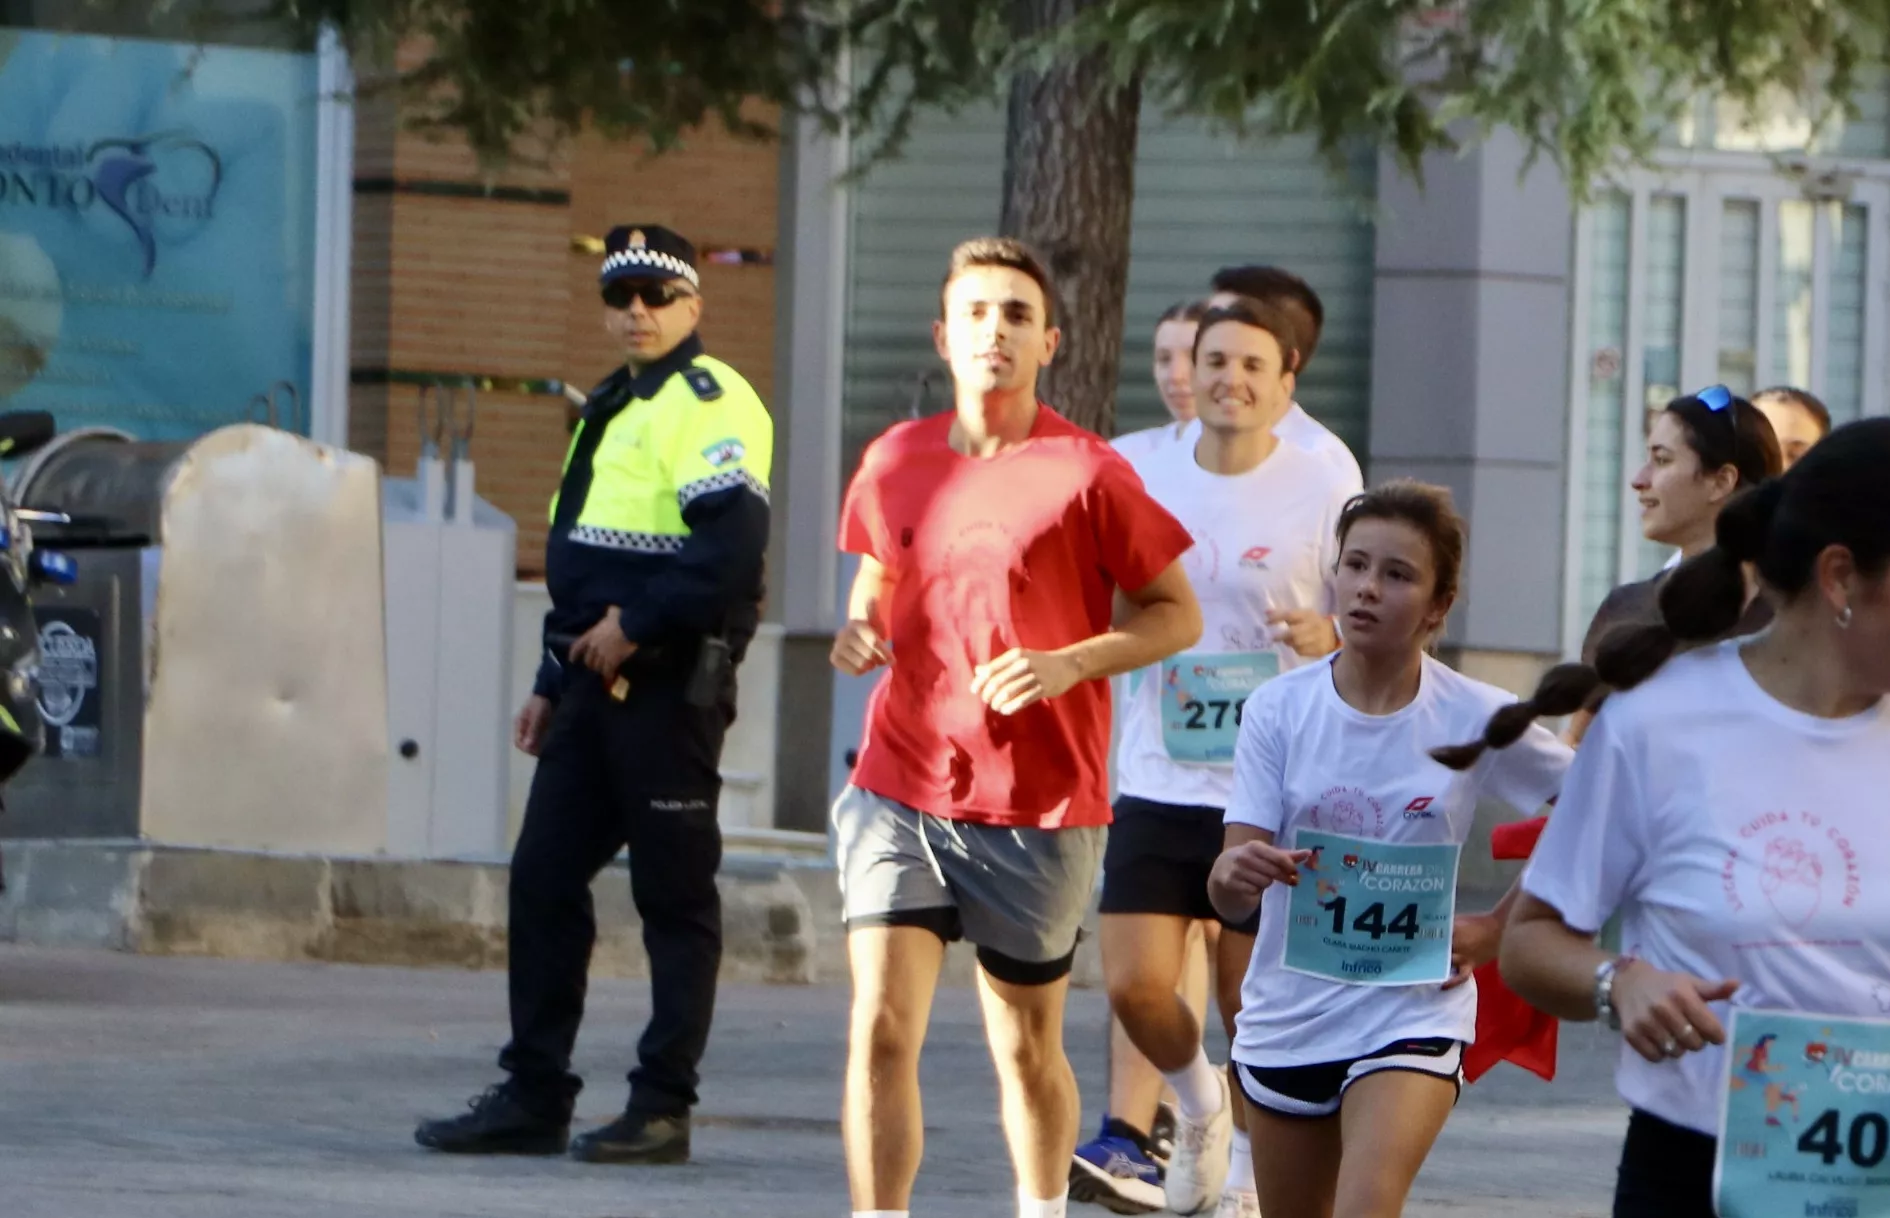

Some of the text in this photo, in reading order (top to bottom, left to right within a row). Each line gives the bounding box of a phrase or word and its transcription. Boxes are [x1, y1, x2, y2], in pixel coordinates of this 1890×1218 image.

[1738, 811, 1789, 839] CUIDA
[1801, 810, 1821, 827] TU
[1324, 896, 1420, 941] 144
[1797, 1108, 1890, 1169] 40
